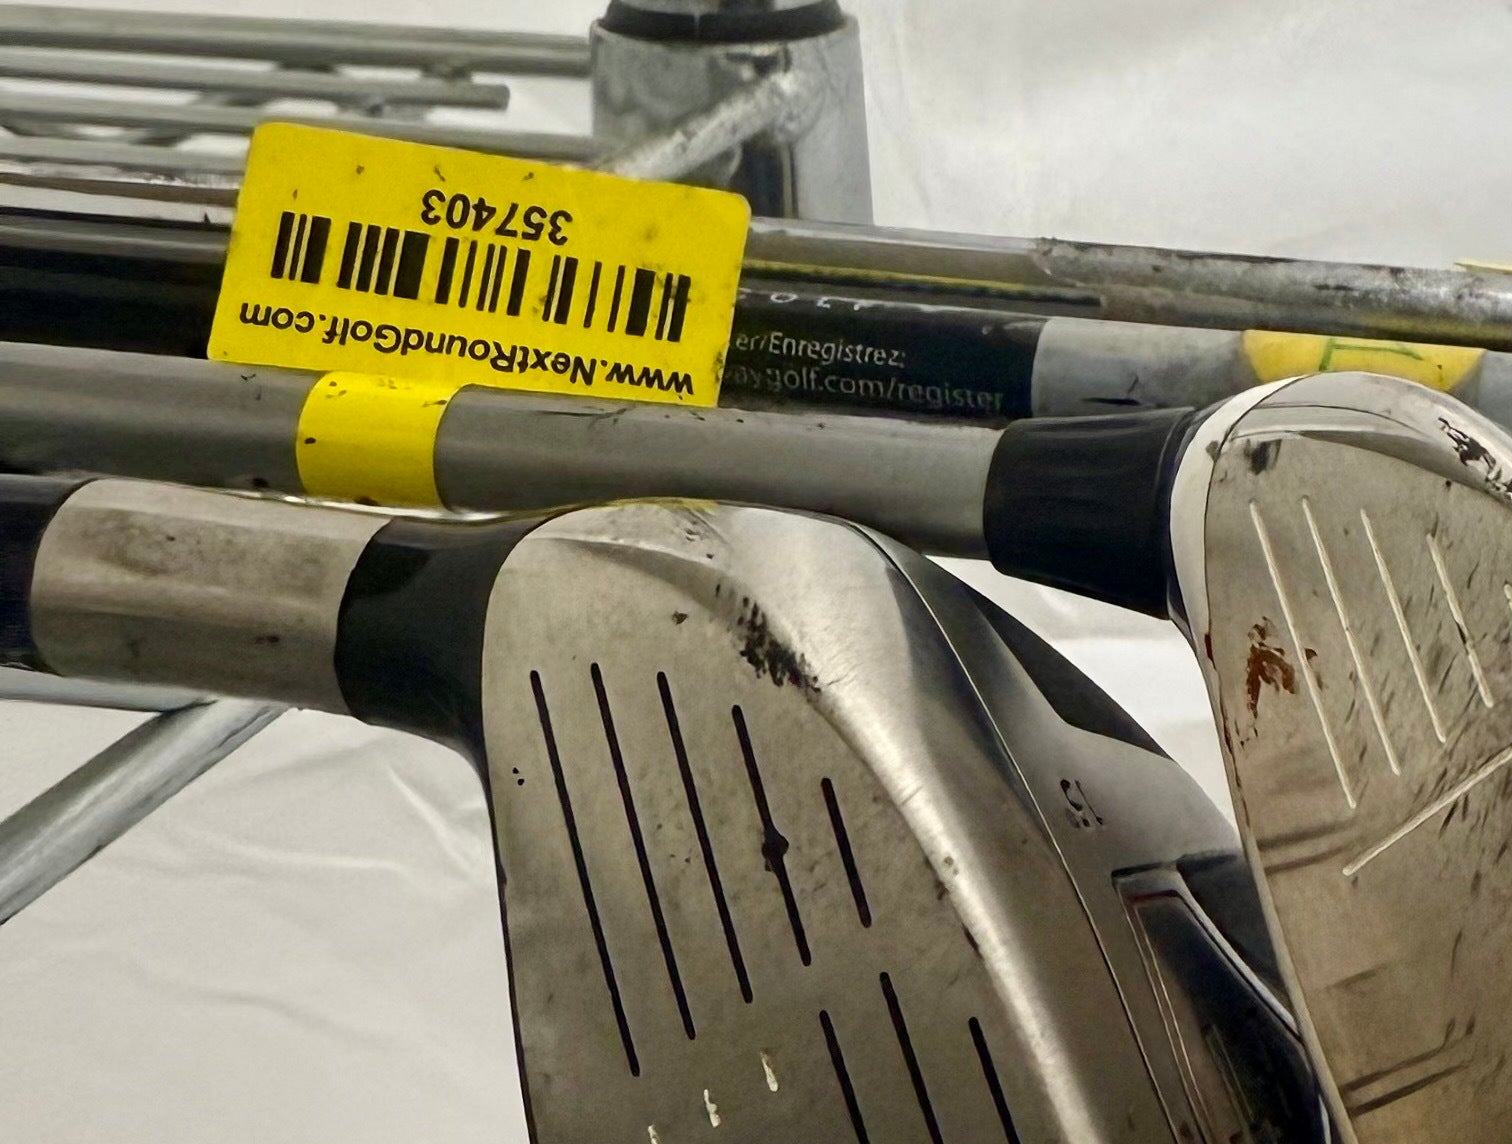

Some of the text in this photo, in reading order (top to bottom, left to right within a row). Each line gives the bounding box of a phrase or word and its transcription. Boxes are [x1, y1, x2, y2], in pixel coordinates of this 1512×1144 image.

[421, 189, 573, 246] 357403
[238, 301, 695, 396] www.NextRoundGolf.com
[734, 330, 906, 369] er/Enregistrez:
